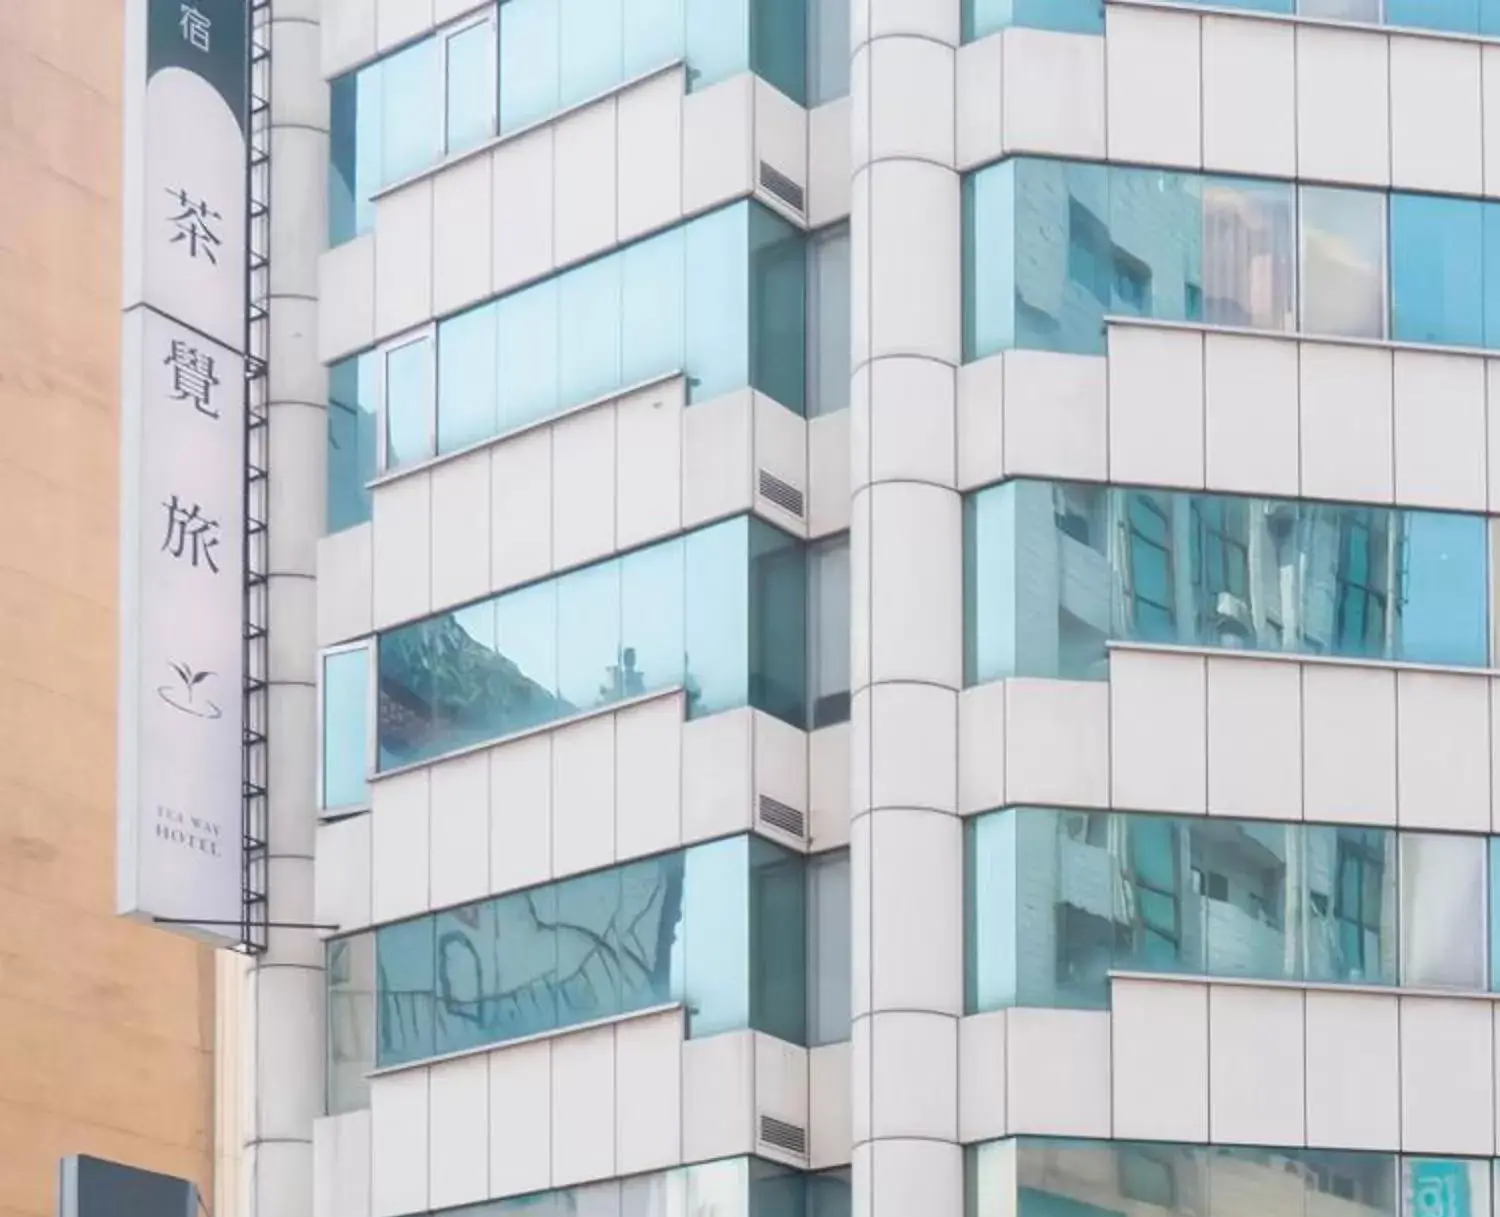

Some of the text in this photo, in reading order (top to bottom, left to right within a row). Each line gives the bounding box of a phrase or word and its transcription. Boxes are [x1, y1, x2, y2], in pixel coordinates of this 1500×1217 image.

[179, 1, 212, 53] 宿
[162, 185, 222, 575] 茶覺旅
